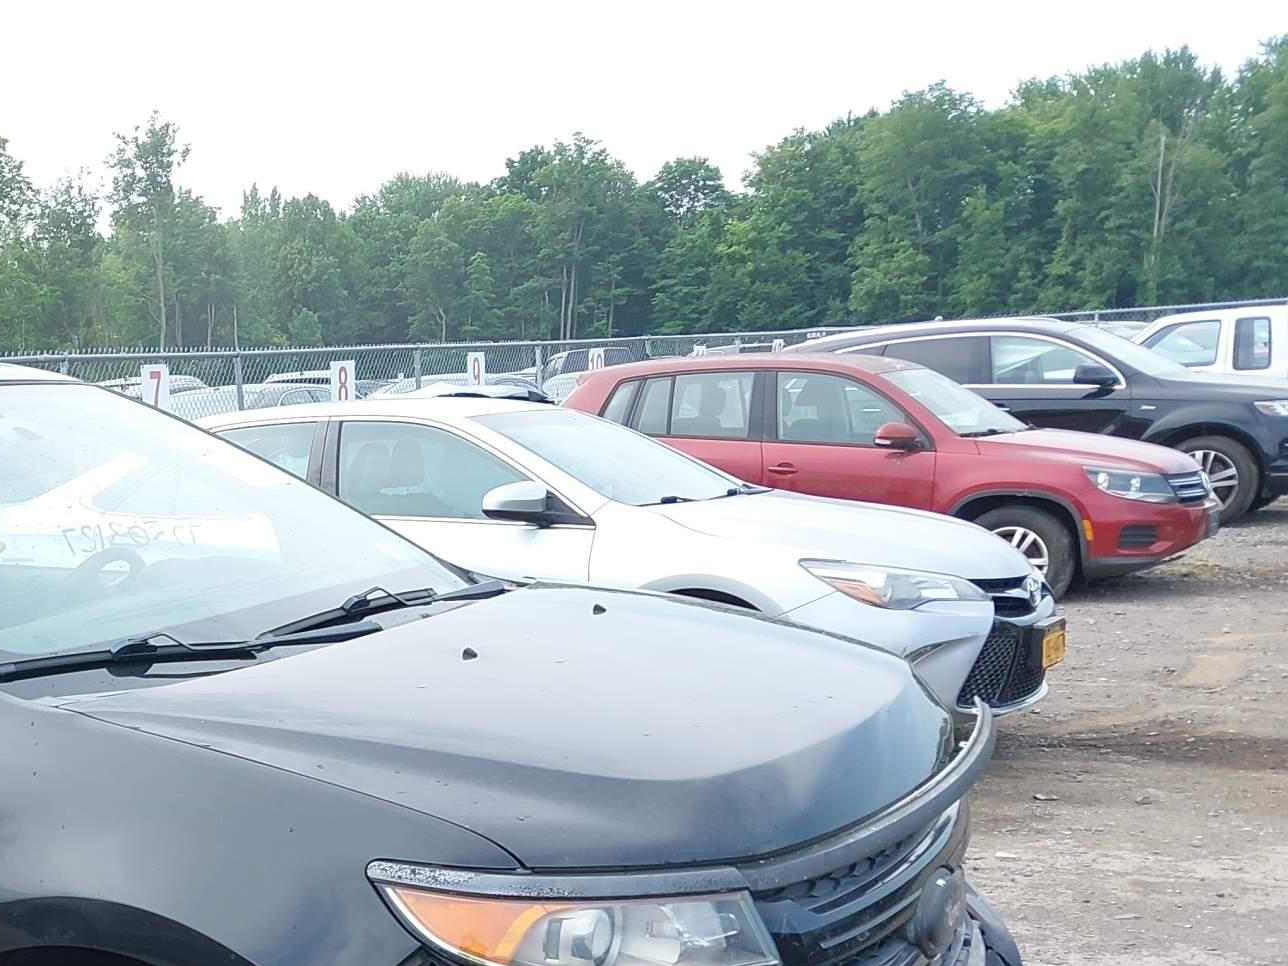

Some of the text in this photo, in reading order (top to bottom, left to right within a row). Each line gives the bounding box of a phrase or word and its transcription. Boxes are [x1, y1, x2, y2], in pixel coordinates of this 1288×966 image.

[338, 366, 349, 401] 8
[472, 357, 481, 385] 9
[149, 370, 162, 408] 7
